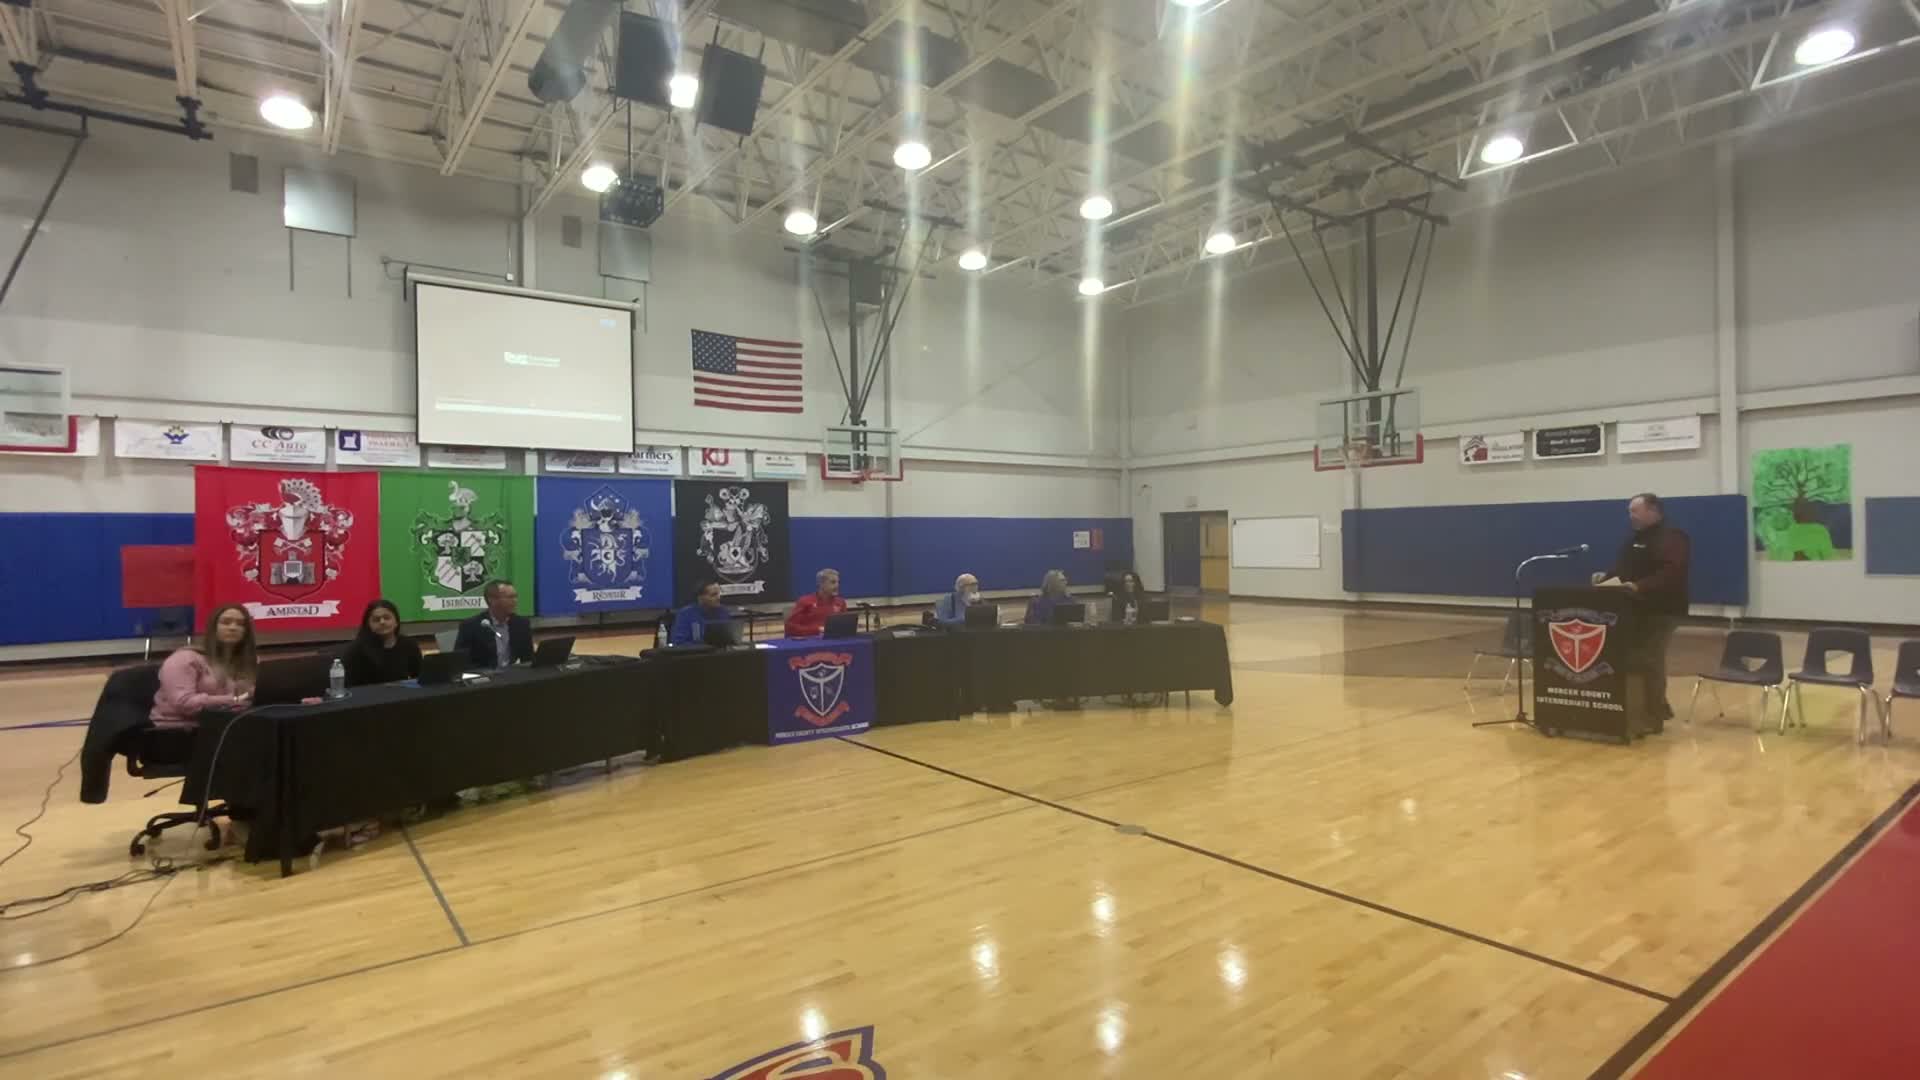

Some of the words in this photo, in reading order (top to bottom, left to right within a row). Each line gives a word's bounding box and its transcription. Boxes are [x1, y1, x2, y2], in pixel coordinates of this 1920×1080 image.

[702, 448, 729, 466] KU
[267, 605, 319, 616] AMISTAD
[1581, 690, 1610, 699] COUNTY
[1537, 696, 1590, 708] INTERMEDIATE
[1592, 702, 1623, 711] SCHOOL
